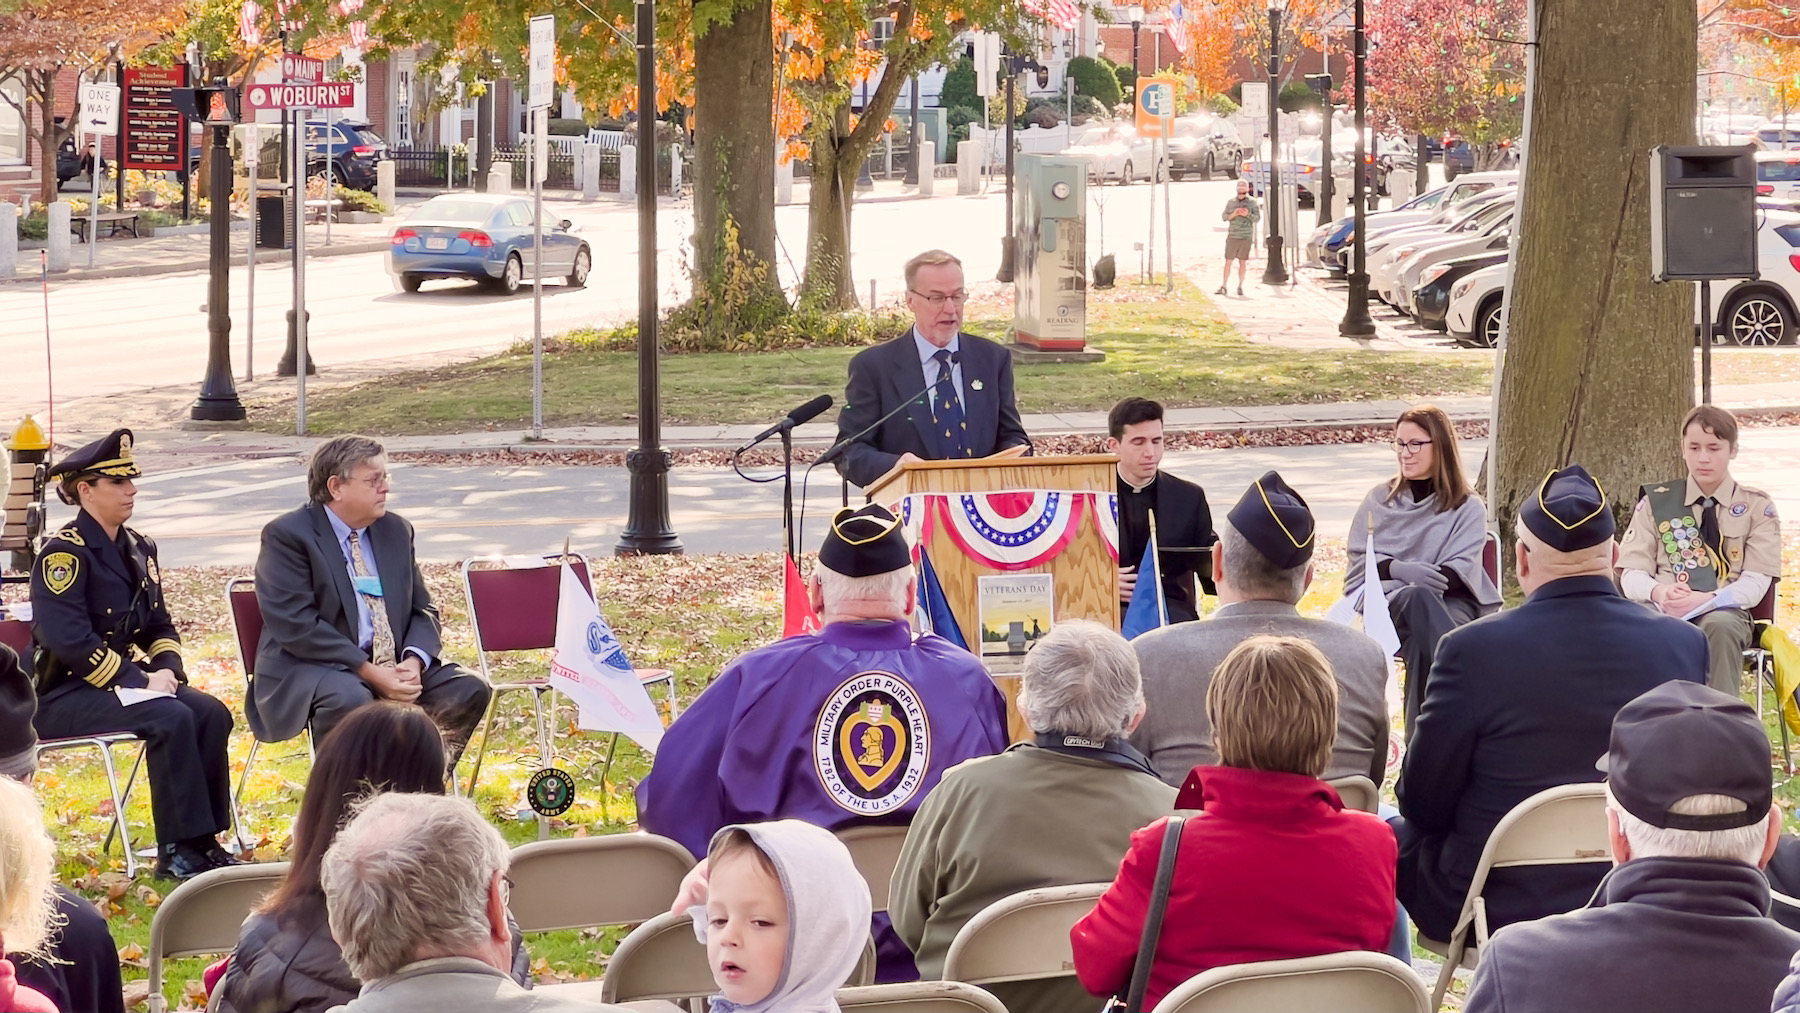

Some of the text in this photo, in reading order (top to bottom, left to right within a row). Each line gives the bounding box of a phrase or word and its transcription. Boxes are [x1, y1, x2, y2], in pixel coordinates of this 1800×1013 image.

[295, 58, 323, 80] MAIN ST
[536, 54, 549, 71] MUST
[130, 78, 177, 86] Achievement
[139, 71, 168, 79] Student
[89, 89, 111, 101] ONE
[270, 85, 351, 106] WOBURN ST
[87, 104, 111, 115] WAY
[984, 584, 1047, 595] VETERANS DAY
[820, 678, 923, 756] MILITARY ORDER PURPLE HEART
[530, 769, 573, 788] UNITED STATES
[822, 757, 919, 810] 1782 OF THE U.S.A. 1932
[540, 808, 560, 816] ARMY
